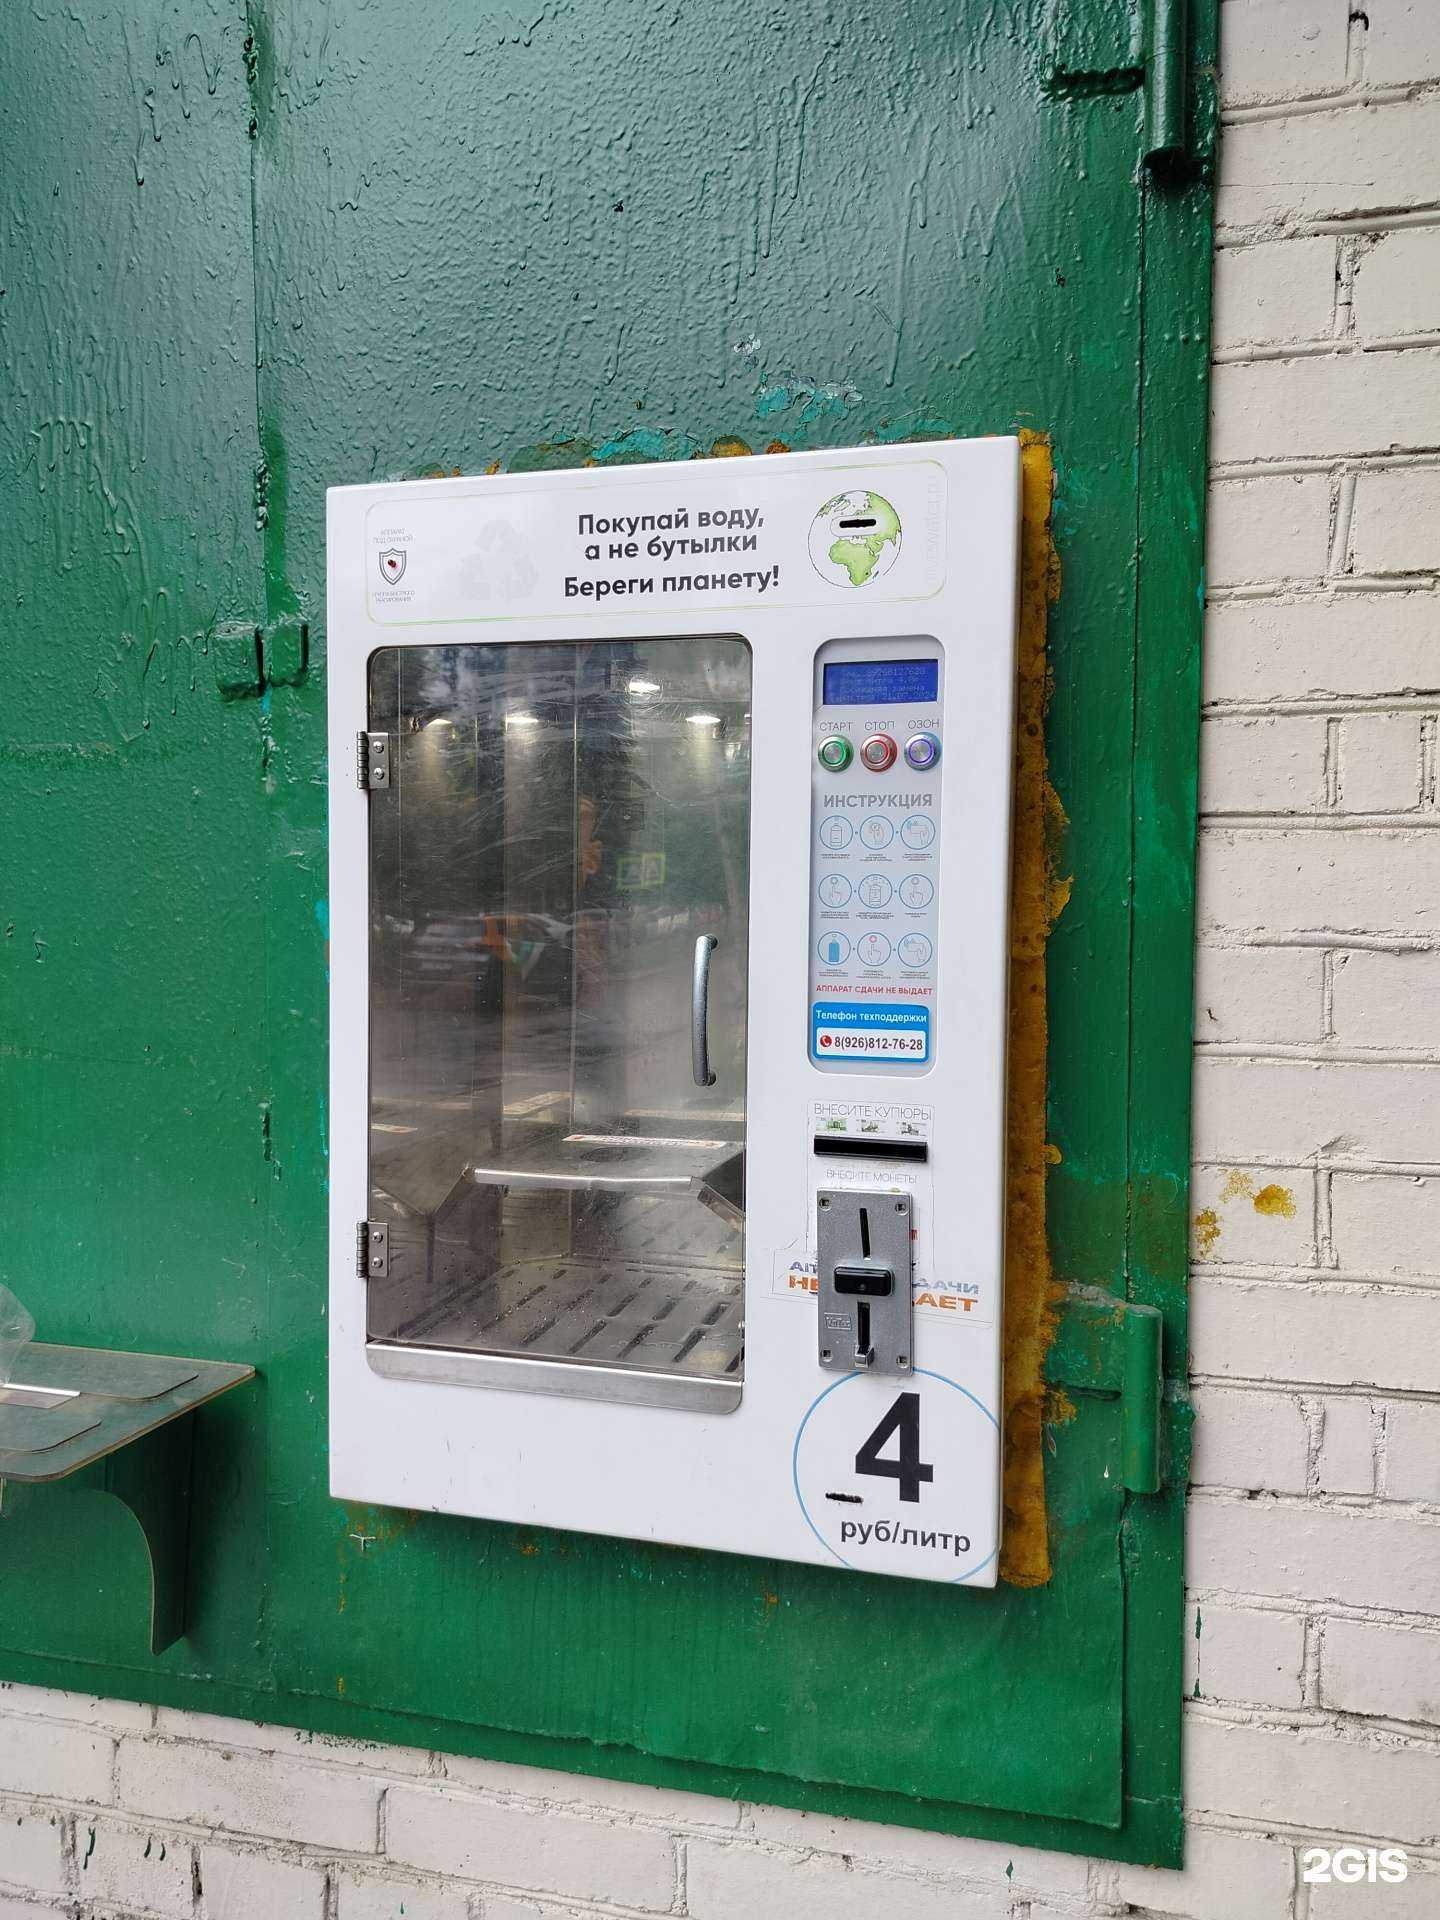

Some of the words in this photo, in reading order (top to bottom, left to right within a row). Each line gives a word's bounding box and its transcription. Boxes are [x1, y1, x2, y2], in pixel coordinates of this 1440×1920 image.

[578, 507, 689, 537] Покупай
[698, 507, 764, 530] воду,
[584, 544, 600, 560] а
[608, 542, 639, 559] не
[647, 535, 757, 561] бутылки
[564, 576, 654, 601] Береги
[662, 564, 780, 593] планету!
[819, 721, 855, 732] СТАРТ
[864, 720, 895, 731] СТОП
[907, 719, 940, 730] ОЗОН
[823, 793, 933, 809] ИНСТРУКЦИЯ
[816, 984, 853, 993] АППАРАТ
[855, 985, 884, 994] СДАЧИ
[886, 986, 897, 995] НЕ
[898, 987, 933, 996] ВЫДАЕТ
[815, 1009, 858, 1021] Телефон
[859, 1012, 928, 1024] техподдержки
[833, 1035, 924, 1051] 8(926)812-76-28
[814, 1102, 872, 1118] ВНЕСИТЕ
[874, 1105, 932, 1121] КУПЮРЫ
[826, 1168, 871, 1181] ВНЕСИТЕ
[873, 1171, 919, 1184] МОНЕТЫ
[855, 1391, 934, 1504] 4
[841, 1519, 971, 1557] руб/литр
